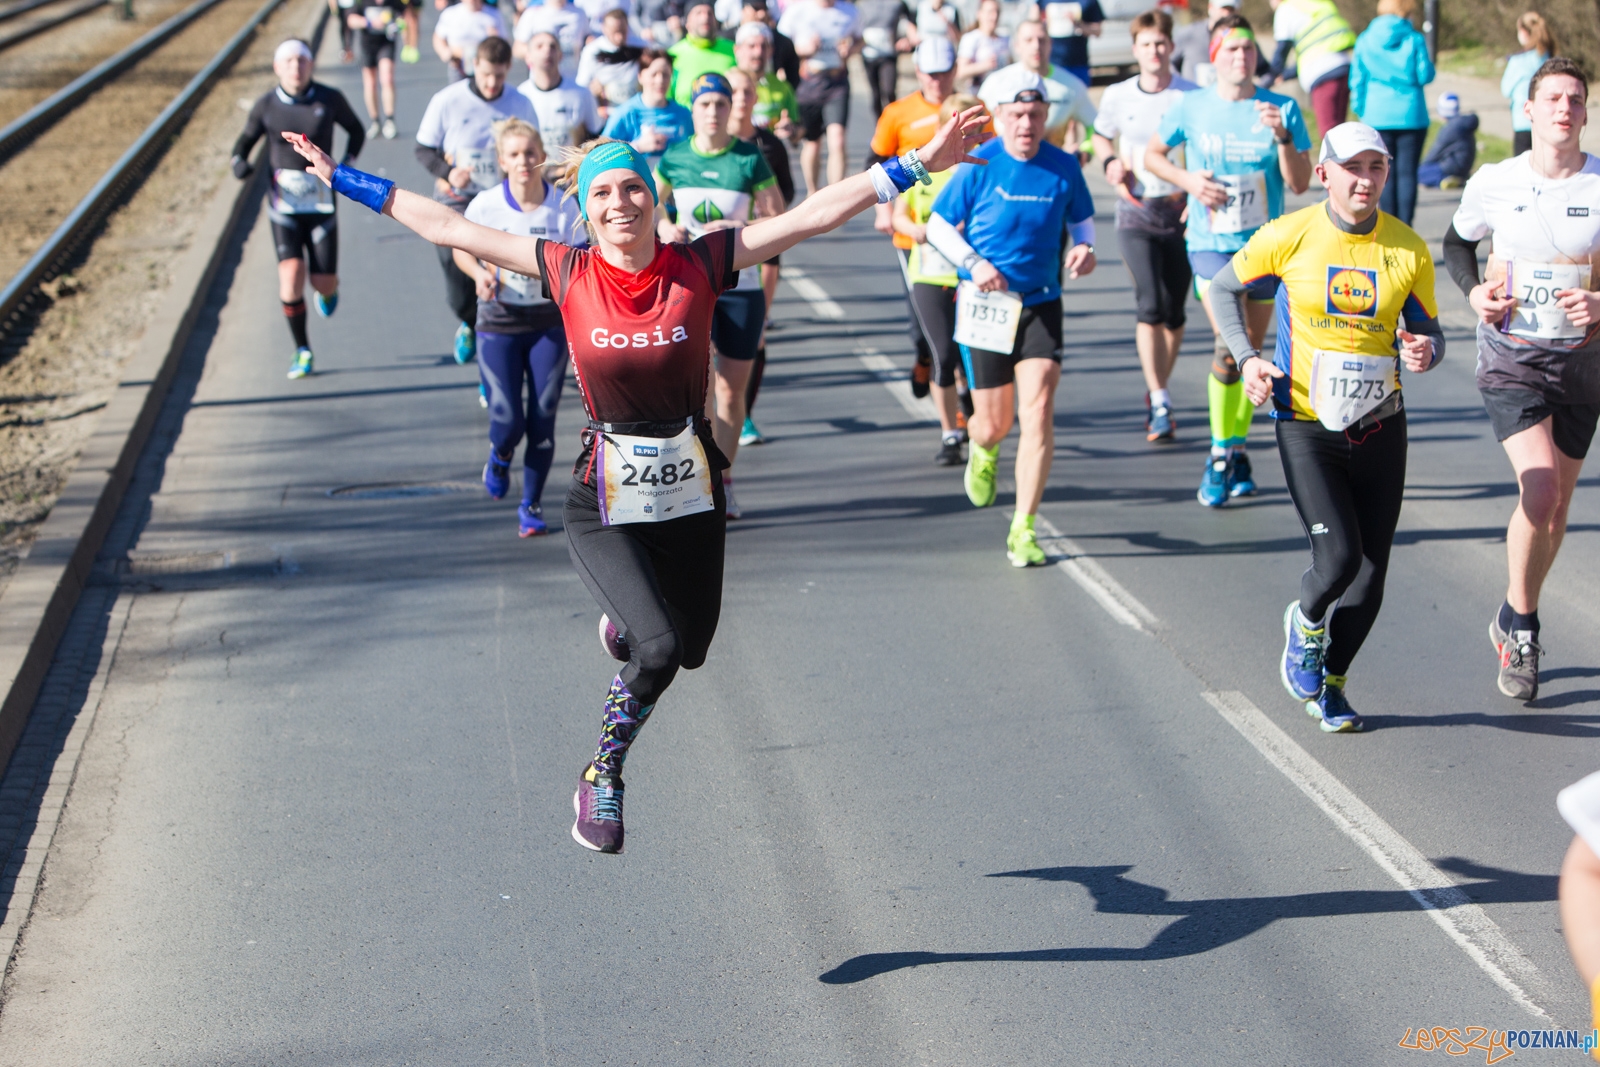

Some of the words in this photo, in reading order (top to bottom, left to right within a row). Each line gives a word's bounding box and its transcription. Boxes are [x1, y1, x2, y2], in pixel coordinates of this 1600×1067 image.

[1523, 284, 1575, 306] 709
[966, 302, 1008, 324] 11313
[1310, 317, 1330, 329] Lidl
[591, 325, 688, 349] Gosia
[1329, 376, 1385, 400] 11273
[621, 458, 695, 487] 2482
[638, 486, 683, 498] Małgorzata
